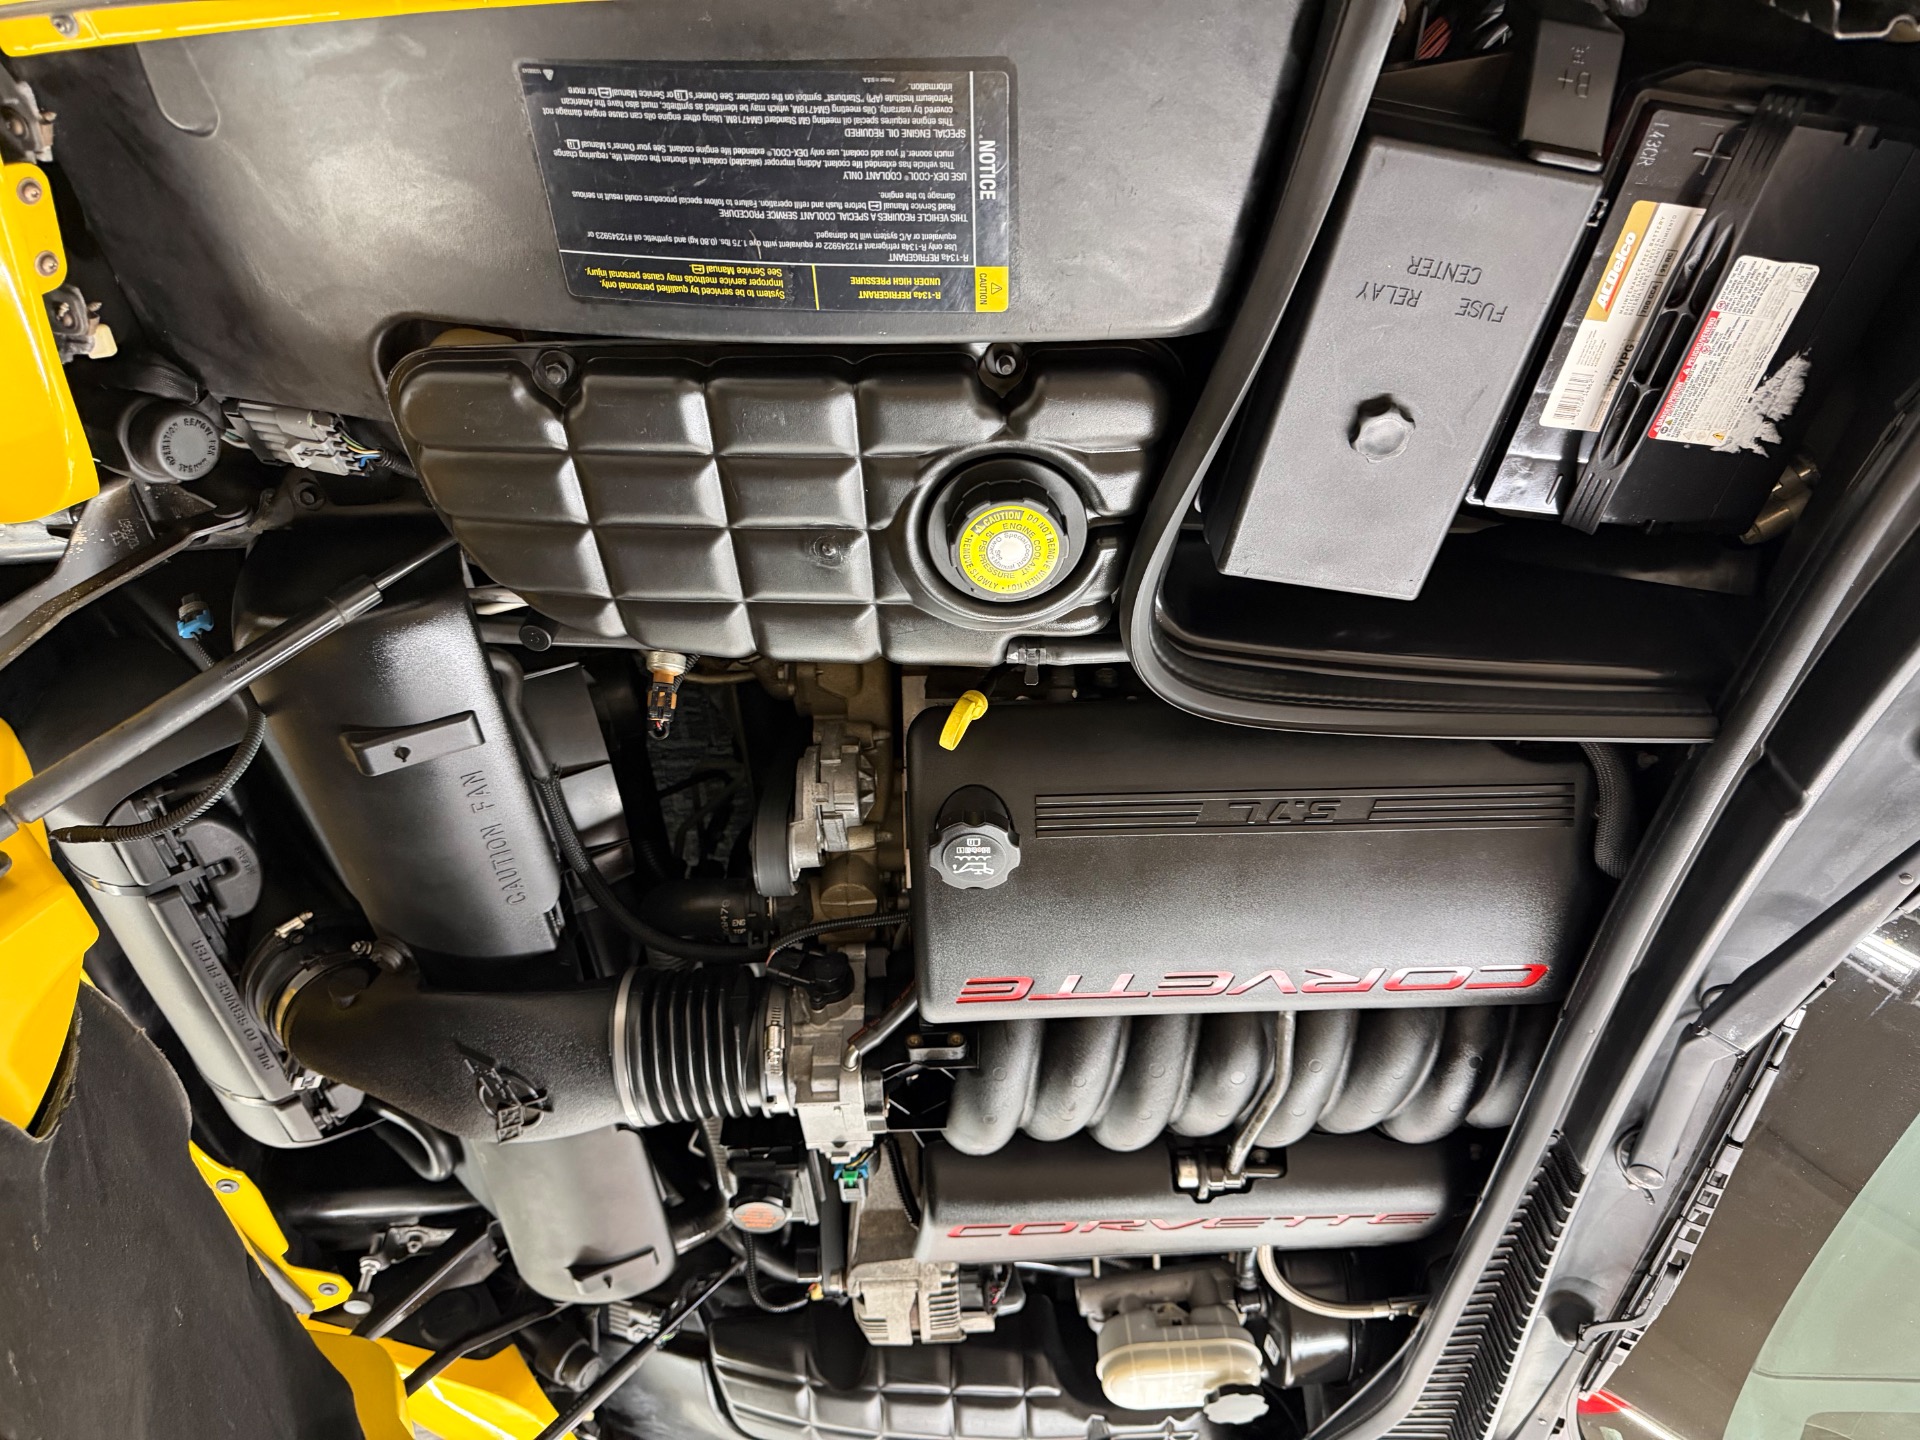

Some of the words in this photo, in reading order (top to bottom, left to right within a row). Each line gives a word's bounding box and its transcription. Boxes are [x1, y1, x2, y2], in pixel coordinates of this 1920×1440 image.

[843, 127, 884, 136] REQUIRED
[886, 128, 899, 136] OIL
[901, 128, 930, 137] ENGINE
[933, 129, 966, 138] SPECIAL
[842, 170, 863, 178] ONLY
[979, 140, 996, 200] NOTICE
[865, 171, 902, 179] COOLANT
[903, 172, 949, 180] DEX-COOL®
[950, 172, 967, 180] USE
[642, 193, 677, 202] procedure
[677, 195, 702, 203] special
[926, 191, 955, 199] damage
[757, 198, 793, 206] operation.
[719, 209, 764, 217] PROCEDURE
[765, 210, 797, 218] SERVICE
[799, 211, 835, 219] COOLANT
[837, 212, 869, 220] SPECIAL
[869, 212, 876, 220] A
[917, 213, 949, 221] VEHICLE
[949, 213, 968, 221] THIS
[594, 232, 632, 240] #12345923
[642, 233, 672, 242] synthetic
[814, 230, 848, 238] damaged.
[686, 235, 698, 243] kg)
[698, 236, 717, 244] (0.80
[748, 238, 761, 246] dye
[777, 239, 813, 247] equivalent
[863, 241, 900, 249] refrigerant
[927, 242, 943, 250] only
[889, 252, 939, 261] REFRIGERANT
[940, 254, 968, 262] R-134a
[1664, 251, 1673, 262] RC
[705, 265, 734, 273] Manual
[1618, 267, 1642, 314] MAINTENANCE
[1649, 216, 1665, 246] BATTERY
[583, 266, 607, 275] injury.
[607, 268, 641, 278] personal
[1406, 255, 1482, 286] CENTER
[1598, 232, 1636, 308] ACDelco
[598, 279, 617, 287] only.
[683, 275, 717, 283] methods
[747, 277, 783, 285] Improper
[849, 276, 891, 284] PRESSURE
[913, 277, 940, 285] UNDER
[617, 280, 655, 290] personnel
[655, 283, 688, 292] qualified
[689, 285, 699, 293] by
[980, 272, 988, 305] CAUTION
[755, 288, 785, 296] System
[858, 290, 911, 298] REFRIGERANT
[913, 291, 941, 299] R-134a
[1355, 280, 1422, 308] RELAY
[1640, 298, 1651, 314] 700
[1647, 284, 1658, 299] CCA
[1454, 297, 1508, 323] FUSE
[1686, 315, 1716, 367] PELIGRO/VENENO
[1610, 342, 1635, 382] 75VPG
[983, 511, 1021, 526] CAUTION
[978, 539, 987, 552] PSI
[1026, 513, 1038, 523] DO
[1038, 522, 1051, 537] NOT
[1046, 537, 1055, 569] REMOVE
[1002, 522, 1035, 538] ENGINE
[1021, 539, 1041, 575] COOLANT
[962, 536, 972, 568] REMOVE
[969, 569, 998, 589] SLOWLY
[979, 553, 1015, 578] PRESSURE
[460, 770, 496, 812] FAN
[1228, 798, 1342, 824] 5.7L
[479, 816, 526, 906] CAUTION
[190, 939, 221, 979] FILTER
[955, 963, 1550, 1004] CORVETTE
[215, 979, 248, 1027] SERVICE
[243, 1027, 258, 1042] TO
[252, 1042, 274, 1070] PULL
[947, 1212, 1438, 1238] CORVETTE
